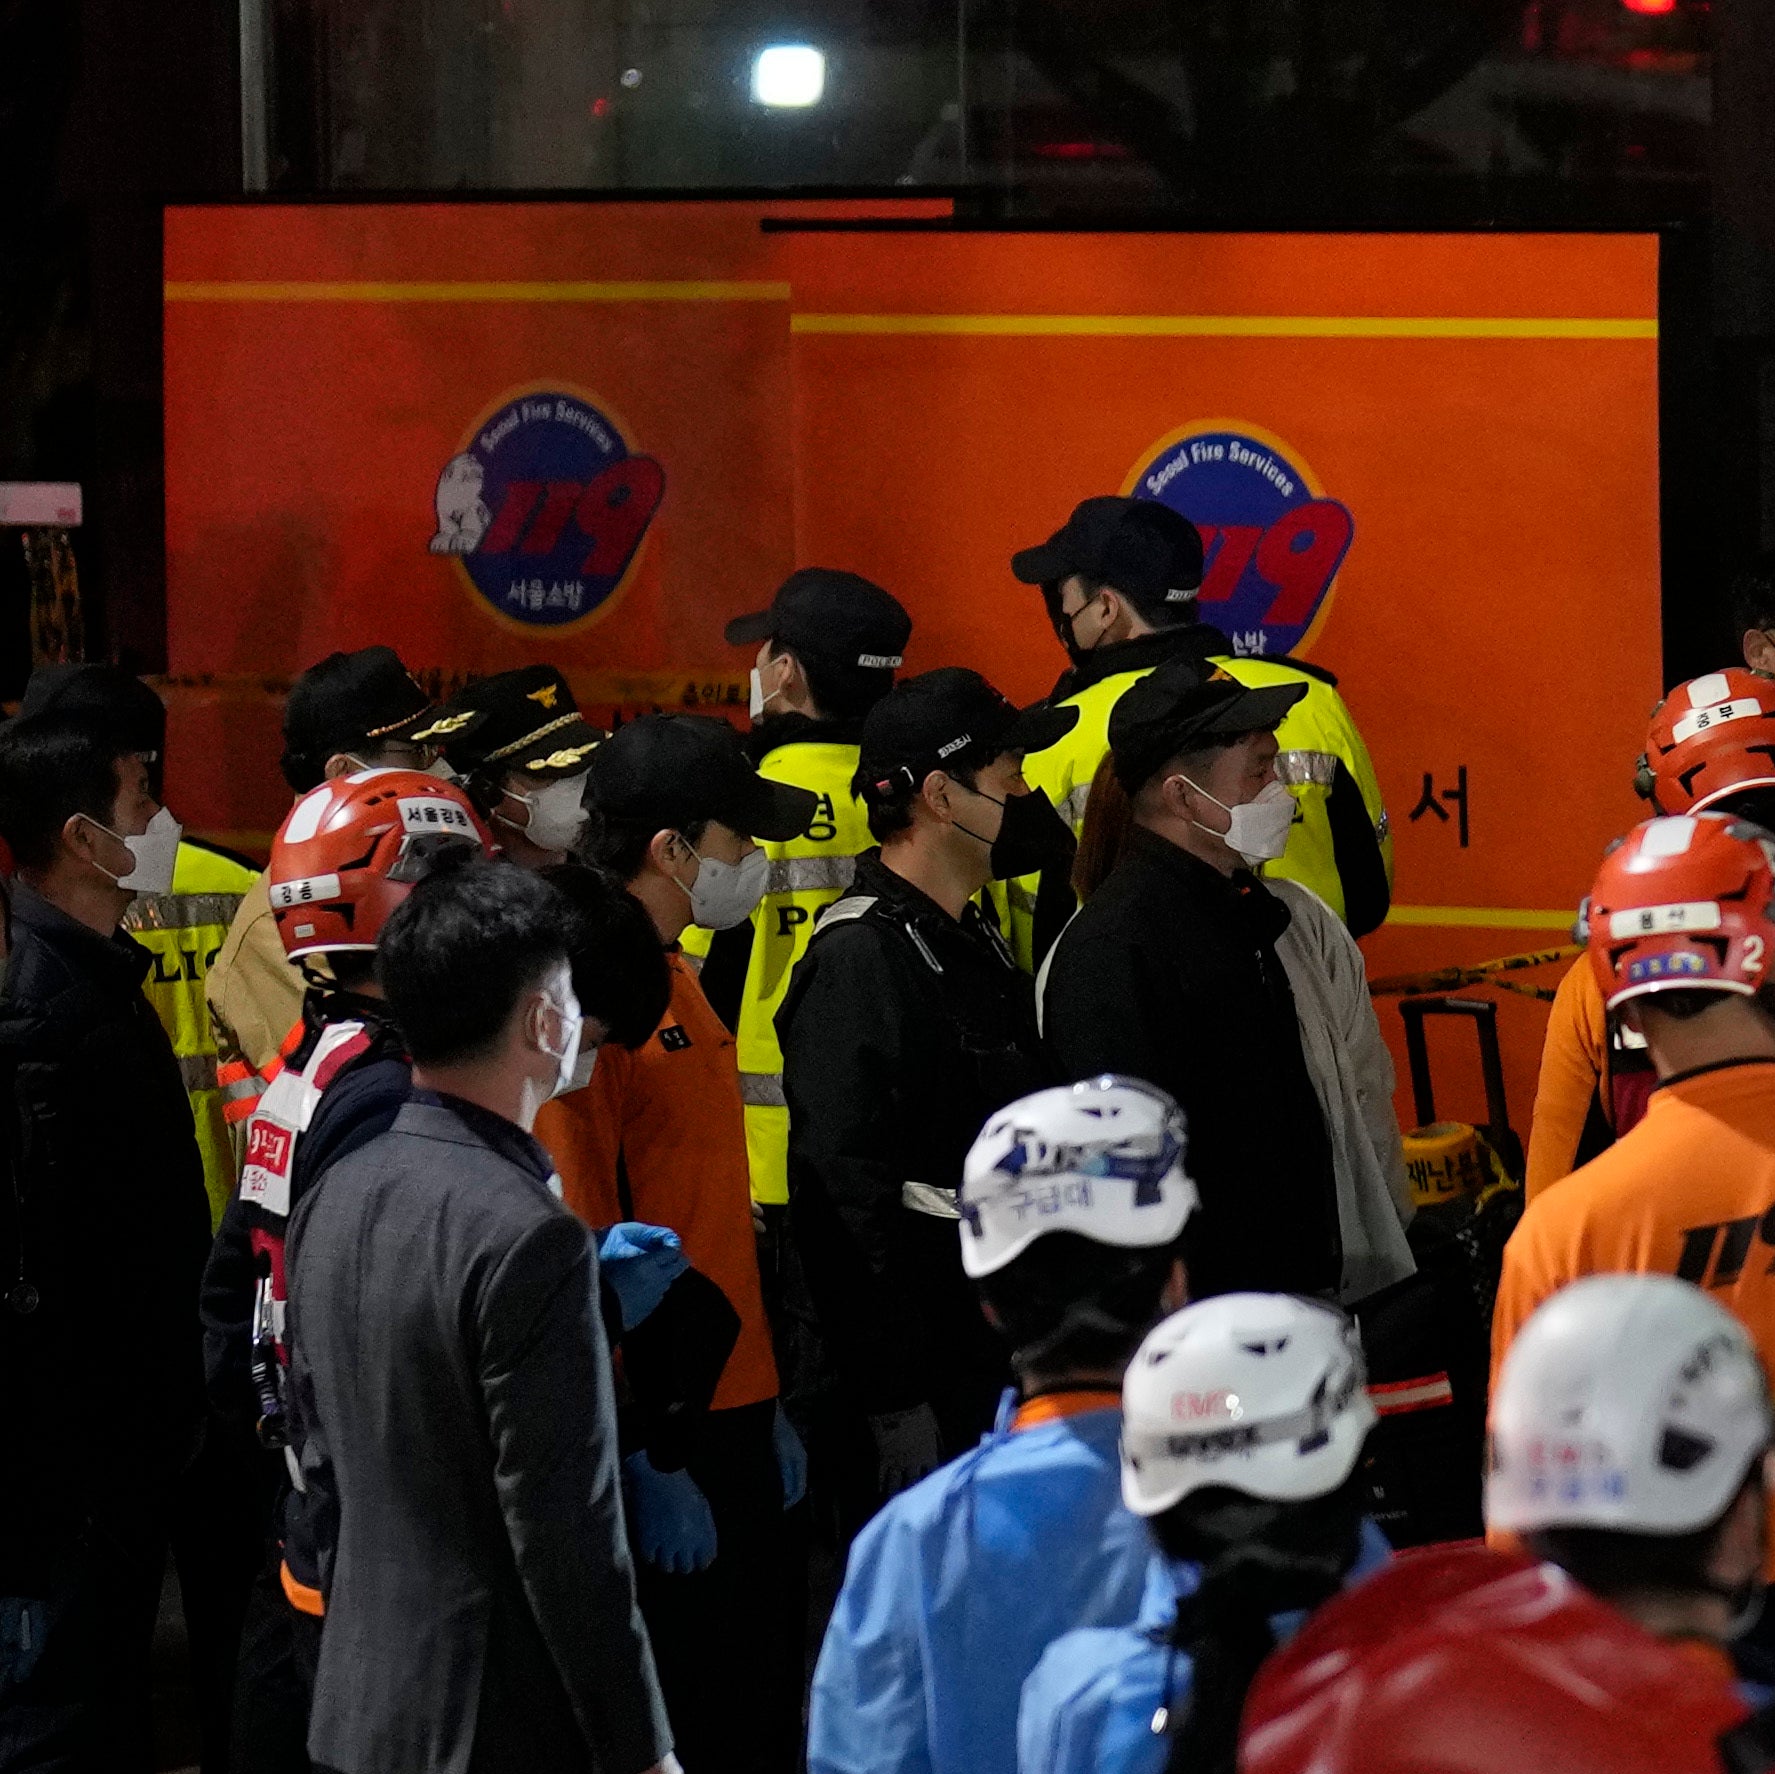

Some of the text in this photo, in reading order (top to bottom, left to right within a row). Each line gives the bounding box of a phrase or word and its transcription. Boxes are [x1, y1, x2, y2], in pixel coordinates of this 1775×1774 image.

[1146, 440, 1294, 498] Seoul Fire Services
[482, 455, 666, 575] 119
[1740, 935, 1765, 972] 2
